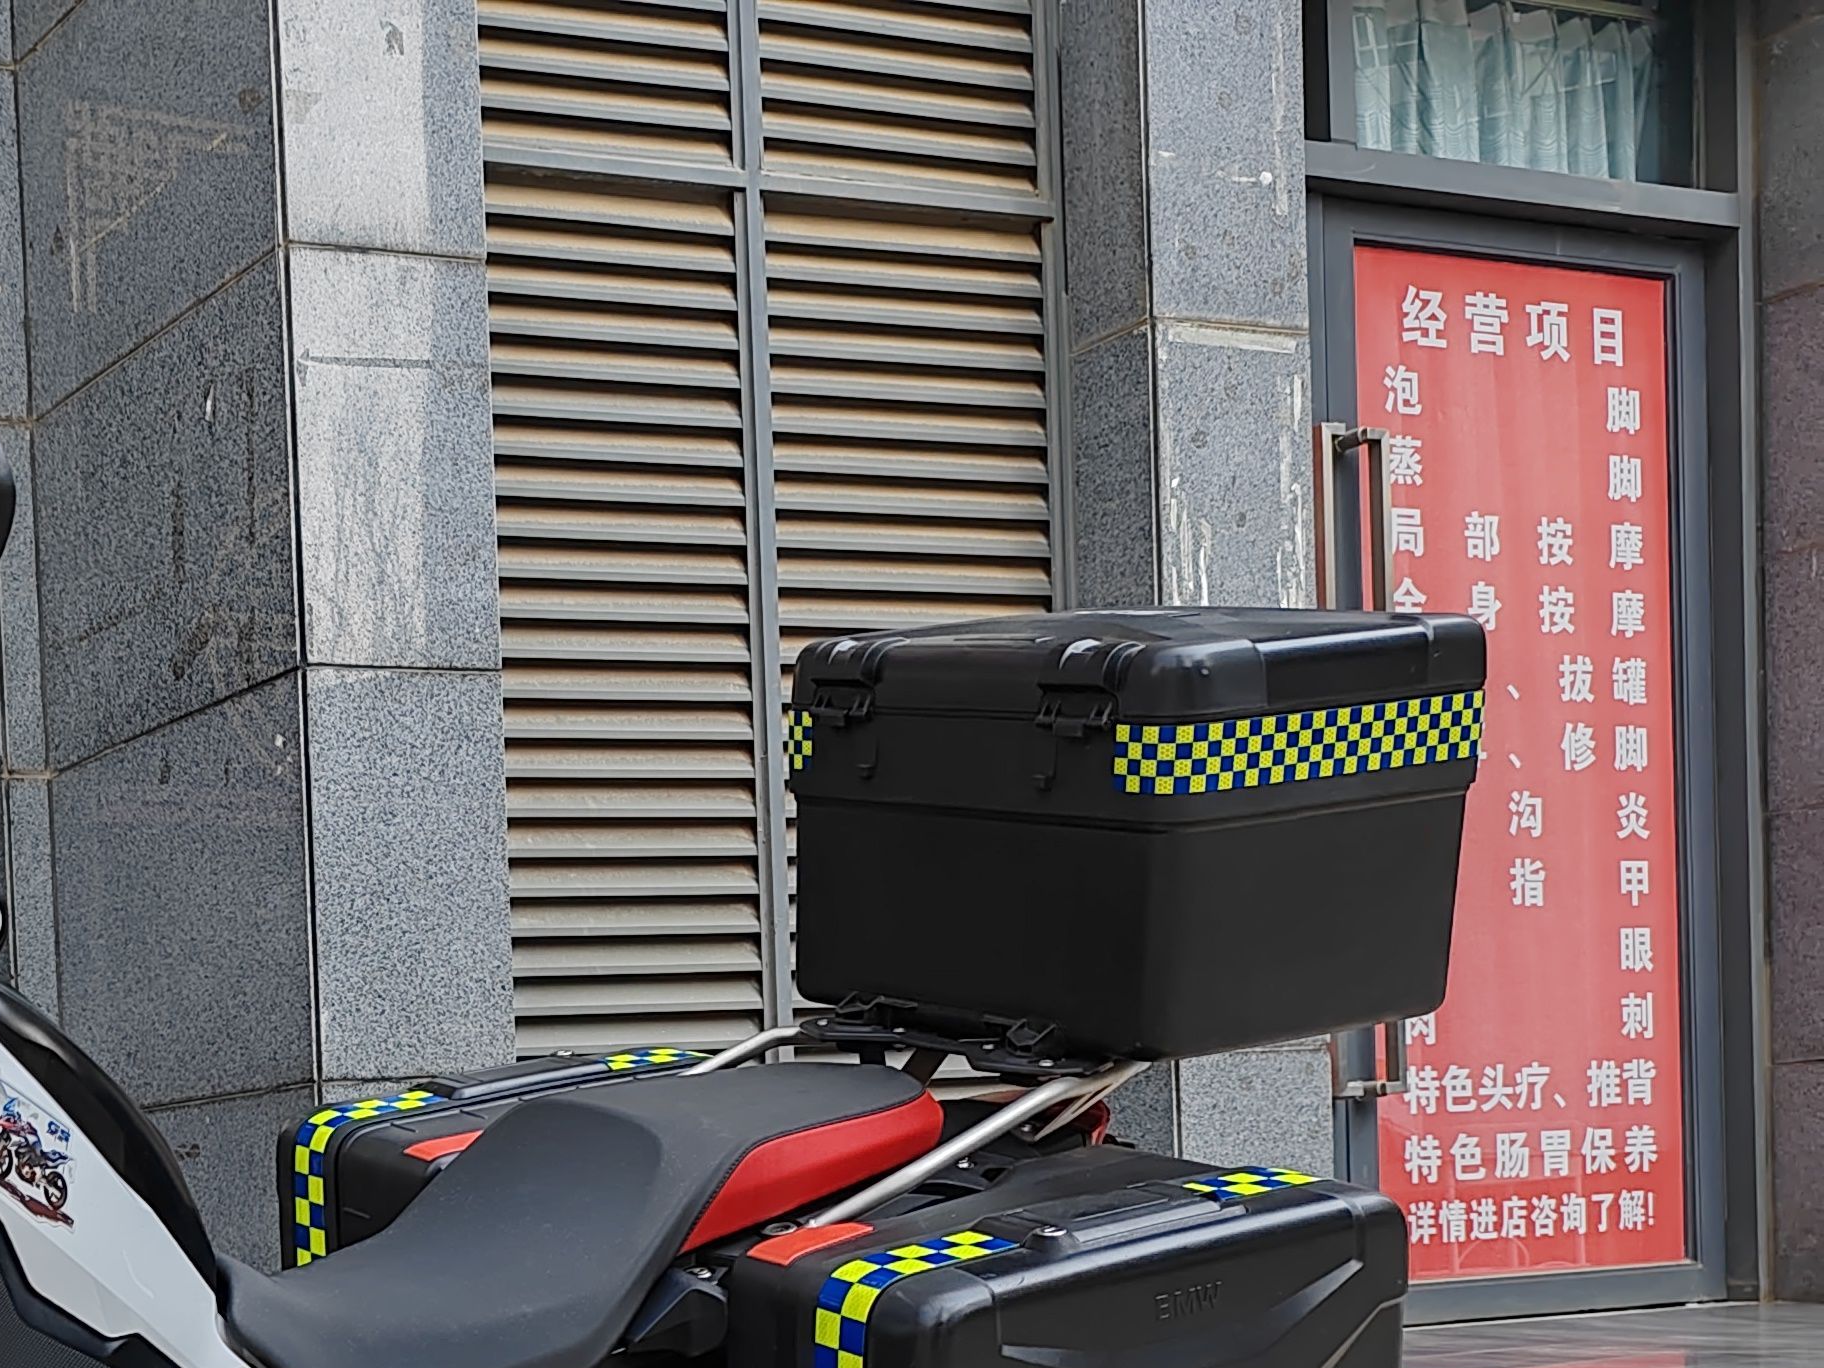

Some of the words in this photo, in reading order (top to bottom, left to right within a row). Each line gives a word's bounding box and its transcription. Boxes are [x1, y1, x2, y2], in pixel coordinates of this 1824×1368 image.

[1401, 285, 1625, 367] 经营项目
[1404, 1058, 1657, 1115] 特色头疗、推背
[1403, 1124, 1659, 1184] 特色肠胃保养
[1154, 1280, 1224, 1322] BMW
